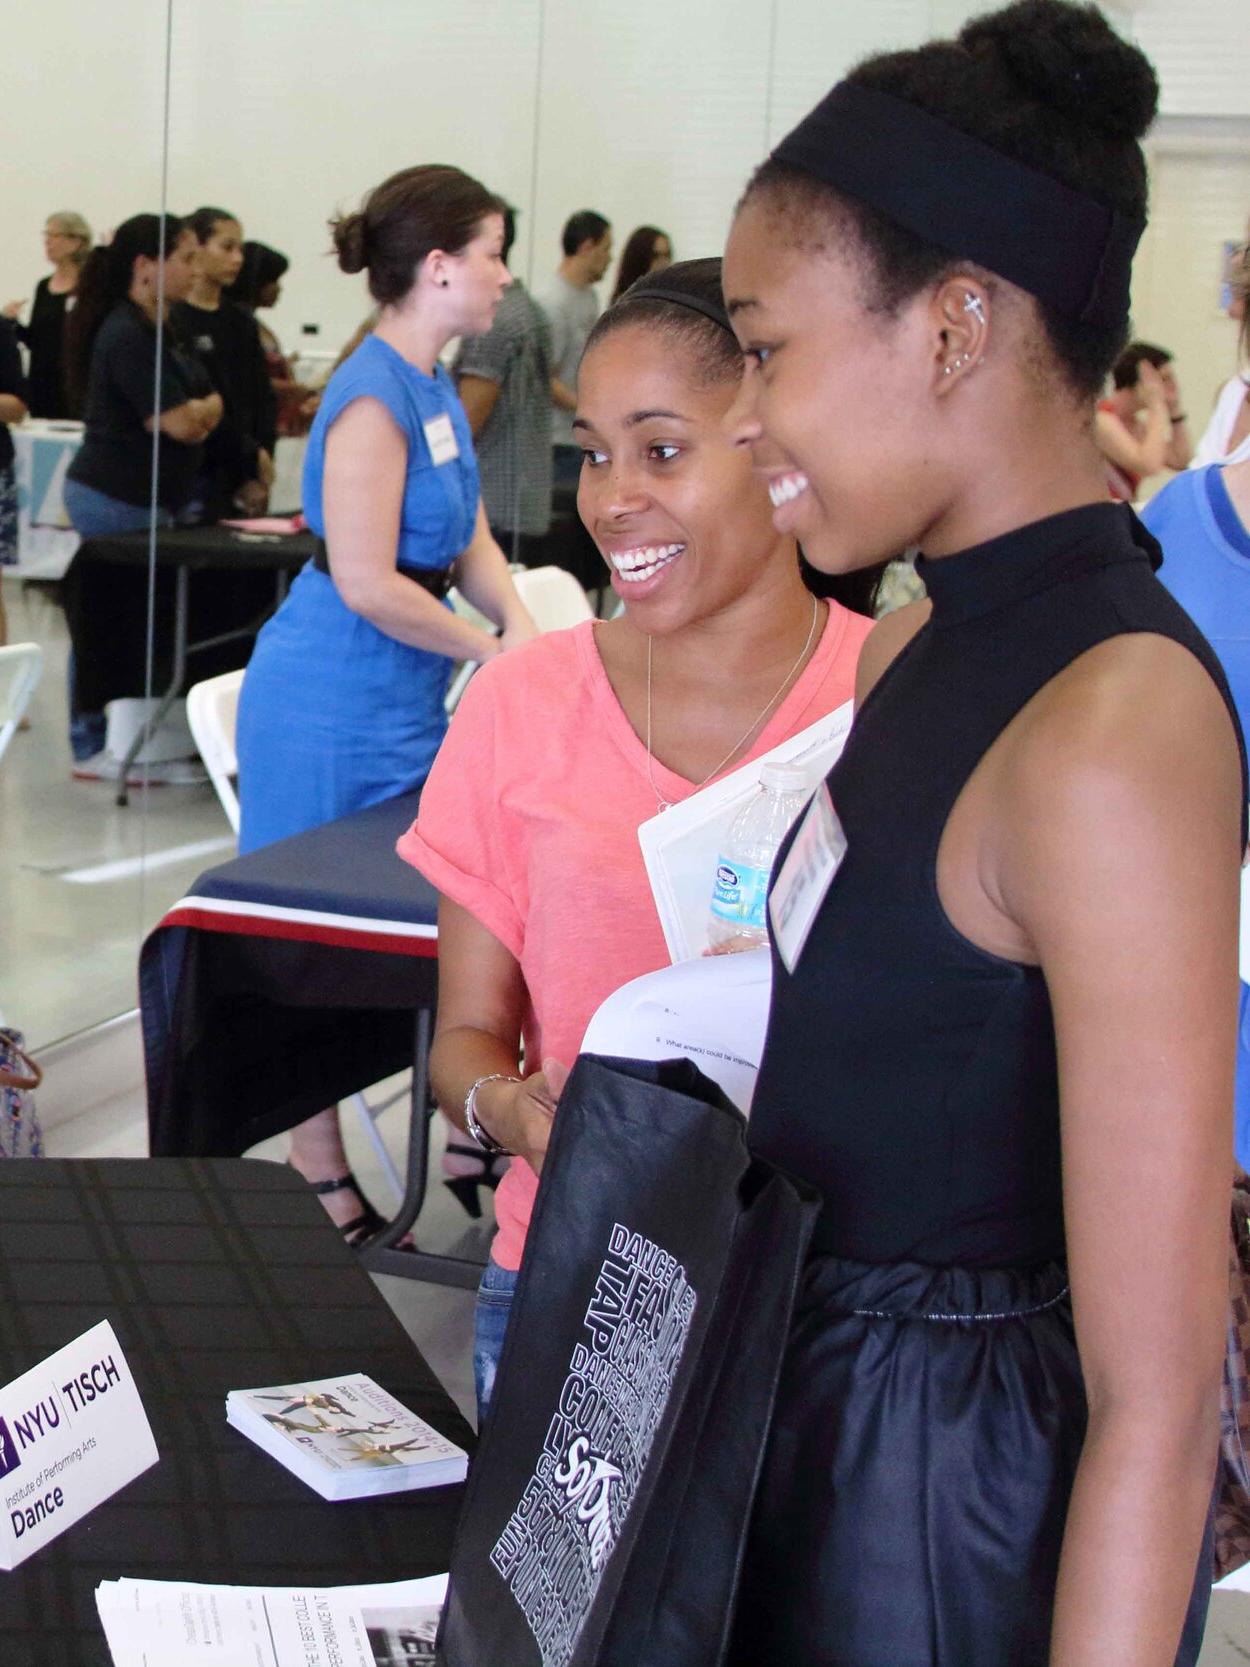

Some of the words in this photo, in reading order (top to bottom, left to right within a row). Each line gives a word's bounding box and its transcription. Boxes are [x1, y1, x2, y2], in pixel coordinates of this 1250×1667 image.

[666, 1039, 682, 1049] What
[706, 1049, 723, 1059] could
[608, 1222, 677, 1288] DANCE
[584, 1260, 638, 1356] TAP
[14, 1396, 60, 1450] NYU
[62, 1355, 121, 1413] TISCH
[336, 1386, 359, 1402] Dance
[354, 1383, 408, 1421] Auditions
[405, 1421, 454, 1454] 2014-15
[5, 1482, 36, 1509] Institute
[35, 1472, 44, 1487] of
[43, 1448, 82, 1481] Performing
[82, 1437, 97, 1454] Arts
[10, 1485, 64, 1538] Dance
[292, 1595, 310, 1621] COLLE
[298, 1621, 315, 1641] BEST
[315, 1601, 328, 1611] IN
[318, 1611, 343, 1667] PERFORMANCE
